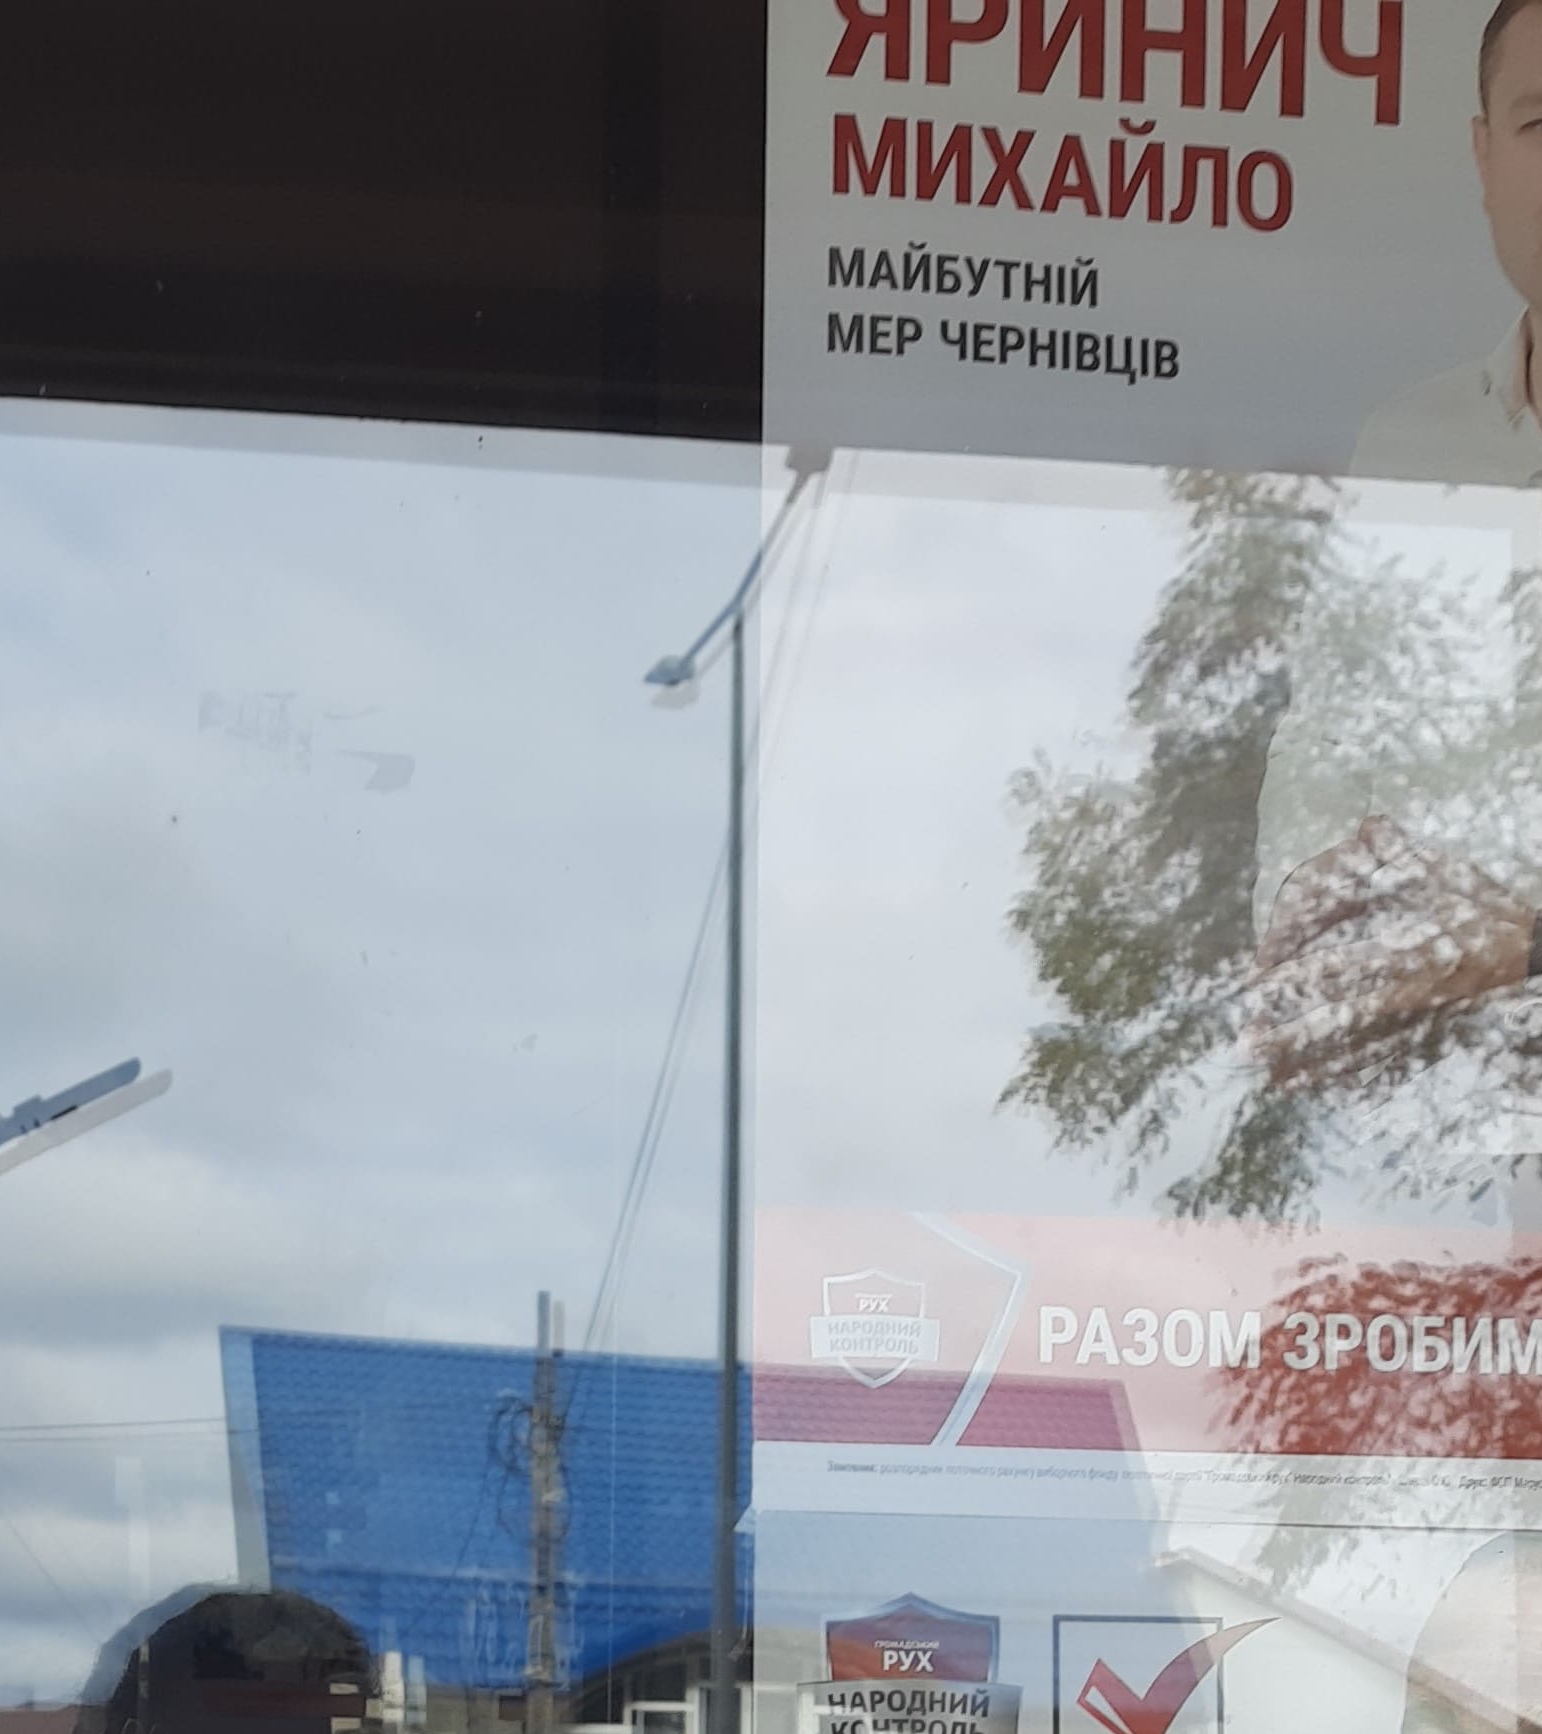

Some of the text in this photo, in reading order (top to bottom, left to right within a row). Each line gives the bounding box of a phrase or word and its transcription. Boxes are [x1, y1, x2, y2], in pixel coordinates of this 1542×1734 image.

[825, 0, 1404, 126] ЯРИНИЧ
[830, 113, 1295, 232] МИХАЙЛО
[826, 241, 1100, 309] МАЙБУТНІЙ
[826, 312, 1180, 386] МЕР ЧЕРНІВЦІВ
[858, 1298, 891, 1313] РУХ
[827, 1321, 922, 1338] НАРОДНИЙ
[828, 1337, 920, 1356] КОНТРОЛЬ
[1038, 1305, 1261, 1370] РАЗОМ
[882, 1650, 935, 1673] РУХ
[827, 1688, 991, 1718] НАРОДНИЙ
